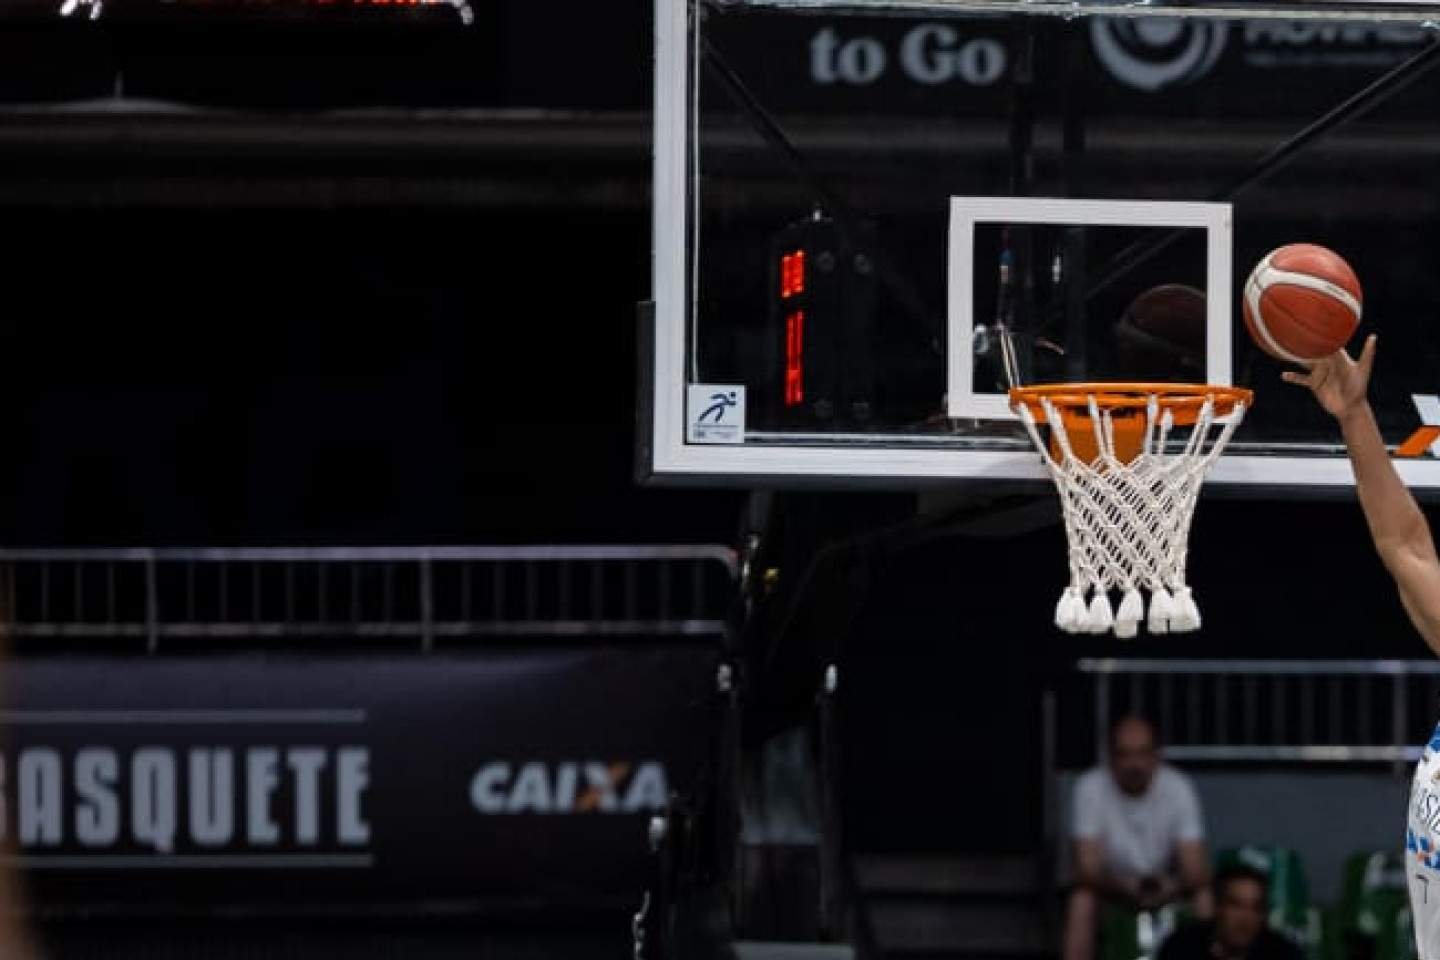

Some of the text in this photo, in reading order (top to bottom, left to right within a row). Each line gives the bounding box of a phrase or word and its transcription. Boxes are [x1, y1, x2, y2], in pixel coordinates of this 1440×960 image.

[811, 25, 1008, 84] to Go
[0, 747, 370, 852] ASQUETE
[470, 762, 669, 813] CAIXA
